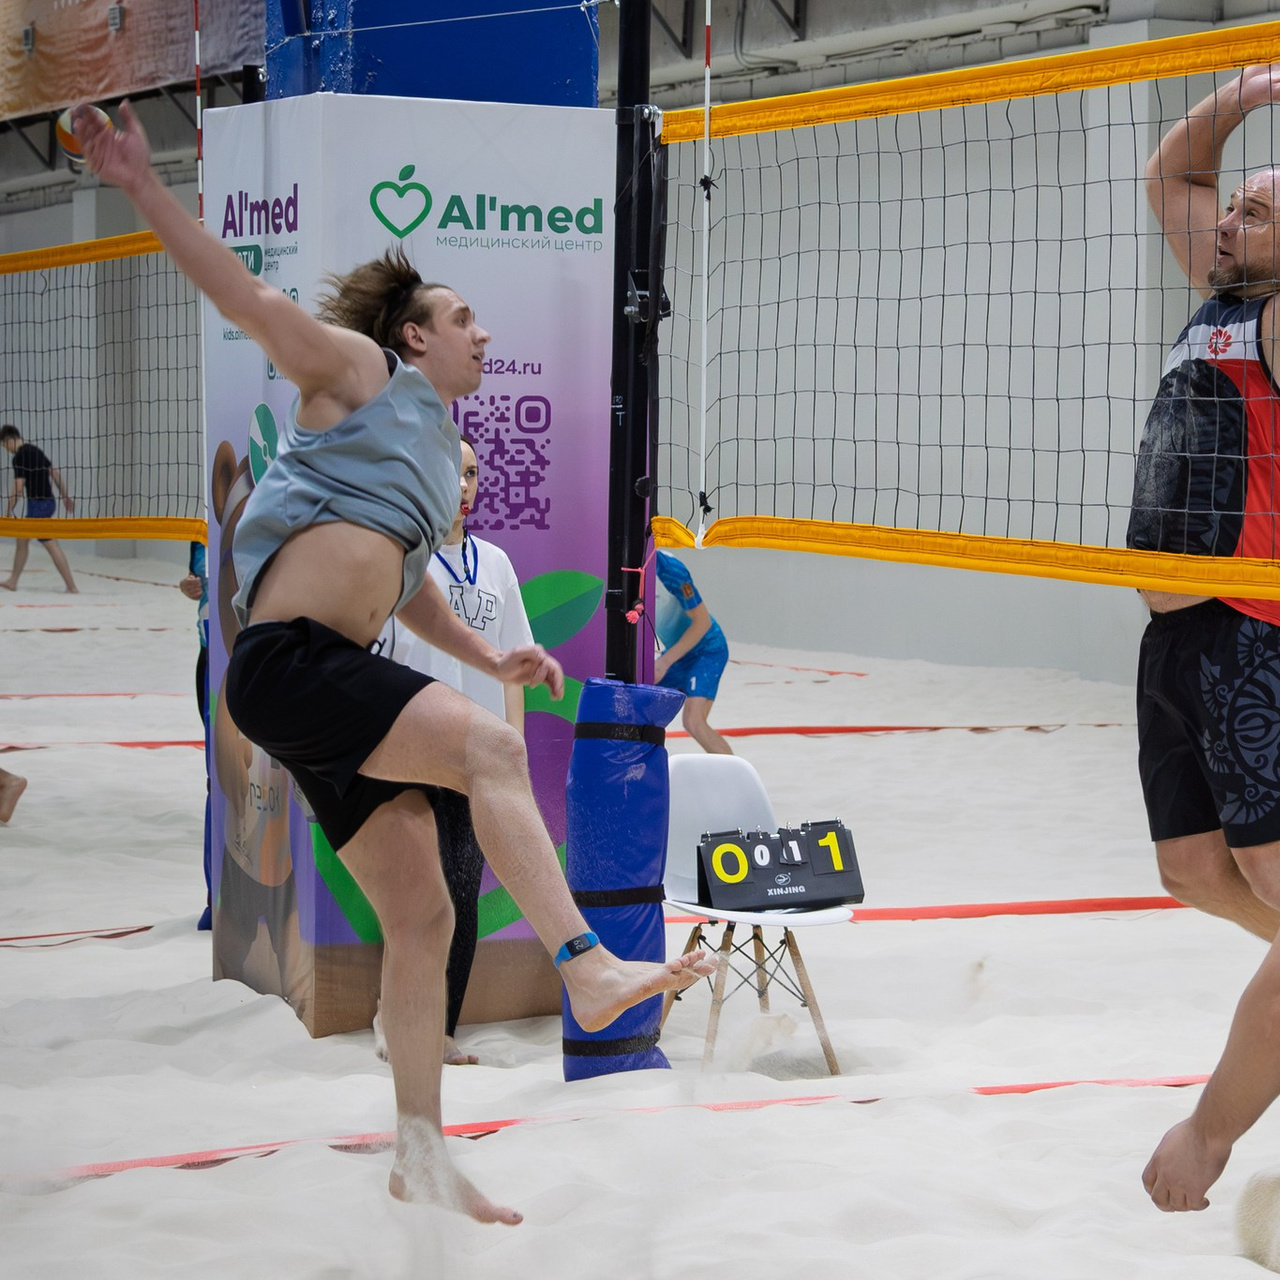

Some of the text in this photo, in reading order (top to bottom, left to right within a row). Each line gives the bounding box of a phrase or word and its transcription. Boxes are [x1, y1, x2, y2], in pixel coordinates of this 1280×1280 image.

[222, 183, 298, 238] Al'med
[437, 194, 603, 234] Al'med
[436, 236, 603, 252] медицинский центр
[482, 358, 542, 375] d24.ru
[449, 584, 497, 631] AP
[689, 676, 697, 691] 1
[753, 844, 771, 867] 0
[788, 840, 802, 862] 1
[817, 831, 844, 871] 1
[767, 885, 806, 896] XINJING
